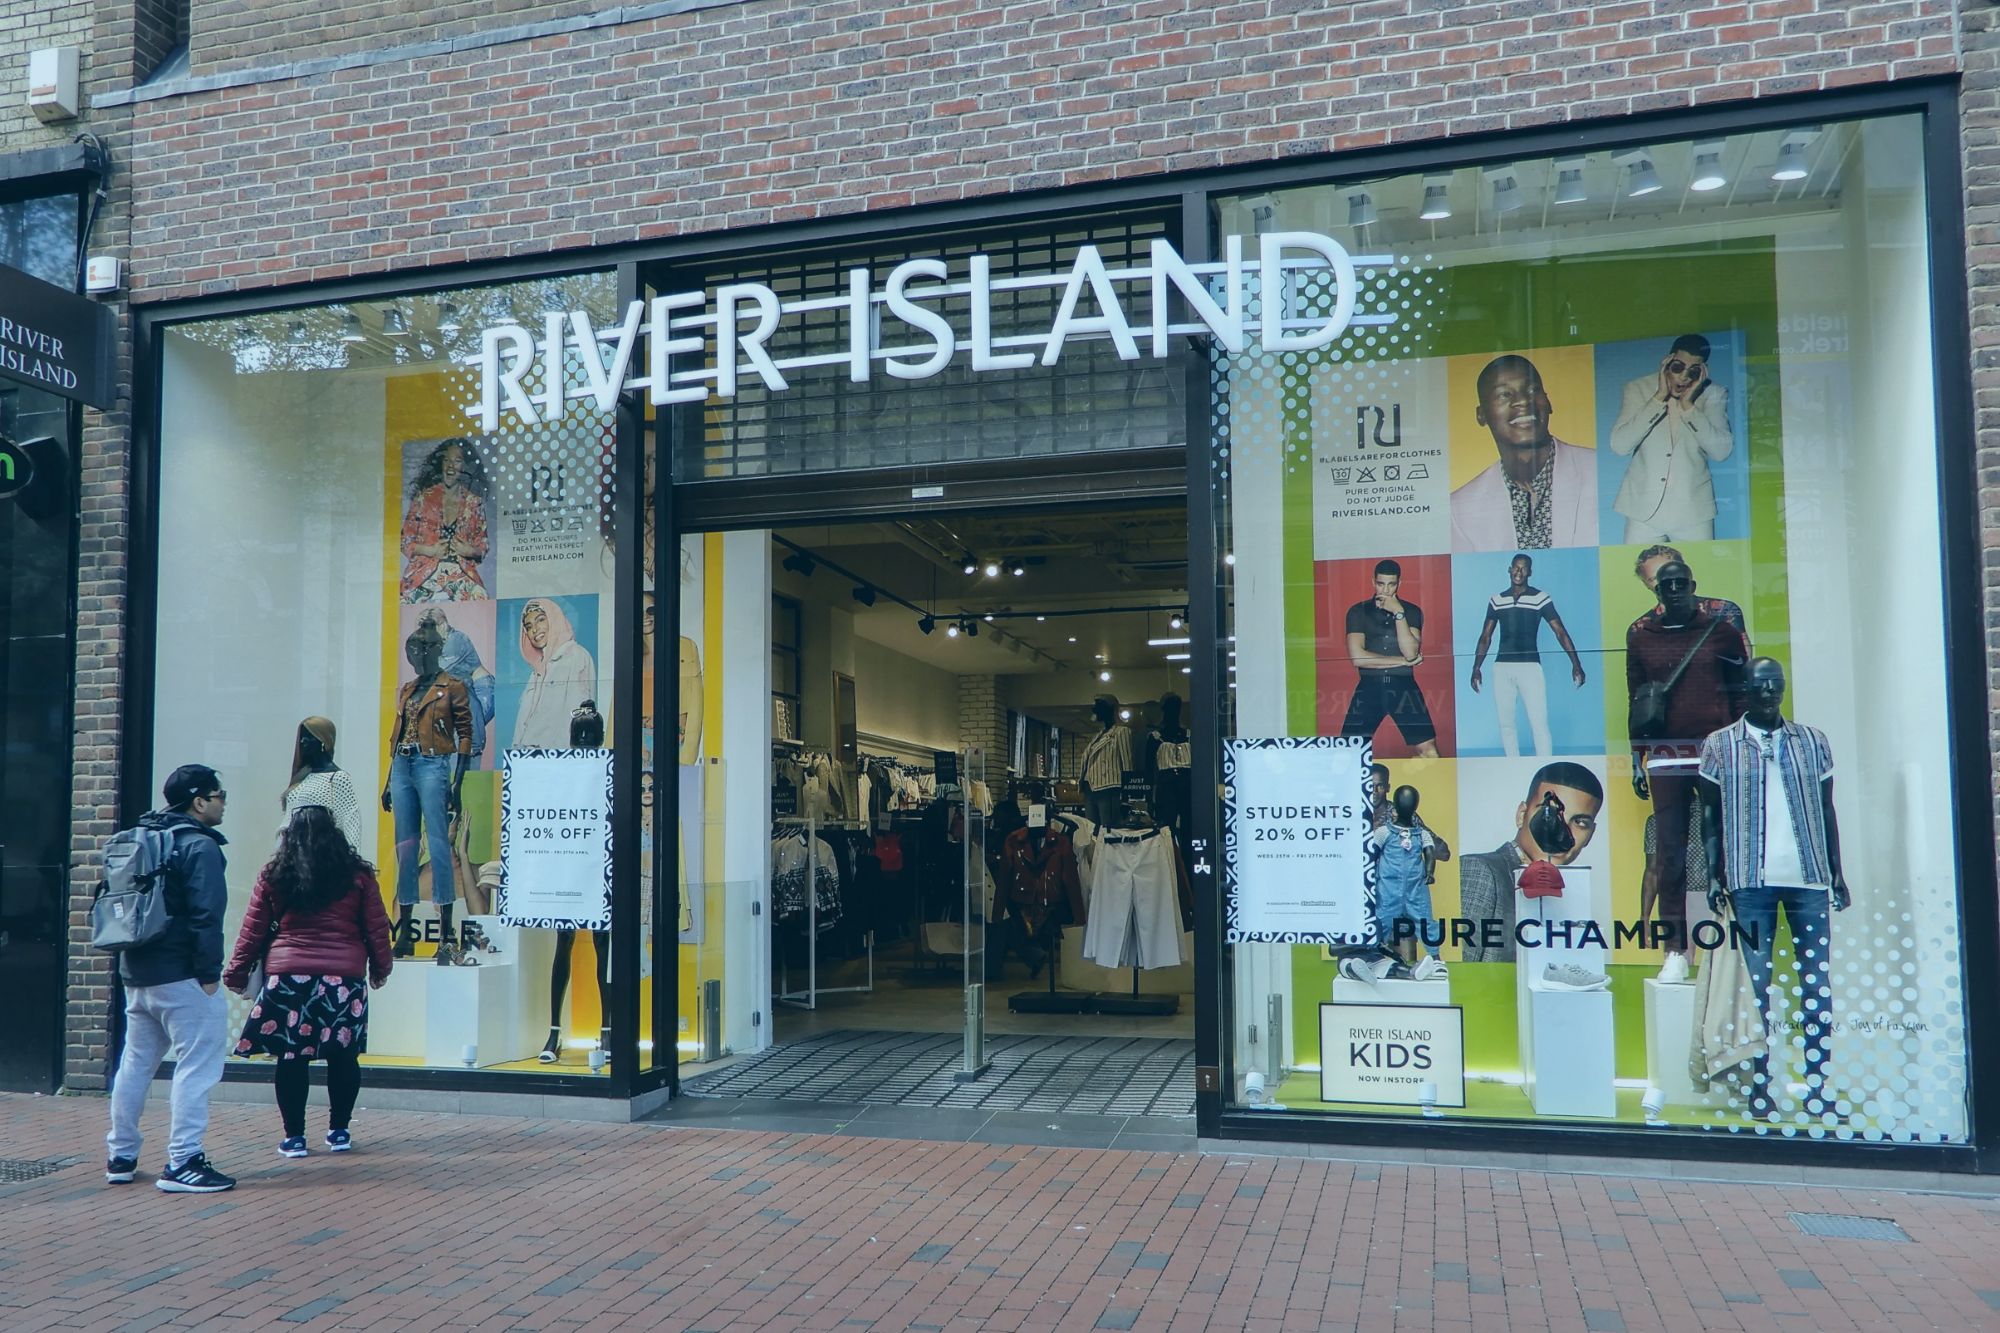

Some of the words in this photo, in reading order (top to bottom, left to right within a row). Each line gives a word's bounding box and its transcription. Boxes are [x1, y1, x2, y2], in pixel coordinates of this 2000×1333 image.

[0, 316, 64, 360] RIVER
[480, 283, 789, 432] RIVER
[849, 231, 1358, 383] ISLAND
[0, 344, 77, 390] ISLAND
[1371, 485, 1416, 494] ORIGINAL
[1385, 494, 1414, 502] JUDGE
[1332, 505, 1430, 518] RIVERISLAND.COM
[554, 541, 584, 550] RESPECT
[511, 552, 584, 563] RIVERISLAND.COM
[517, 808, 598, 820] STUDENTS
[1245, 805, 1353, 820] STUDENTS
[523, 827, 554, 839] 20%
[1254, 827, 1296, 841] 20%
[1391, 918, 1506, 949] PURE
[1514, 917, 1760, 951] CHAMPION
[1349, 1027, 1383, 1040] RIVER
[1388, 1028, 1432, 1041] ISLAND
[1350, 1042, 1432, 1070] KIDS
[1358, 1075, 1380, 1083] NOW
